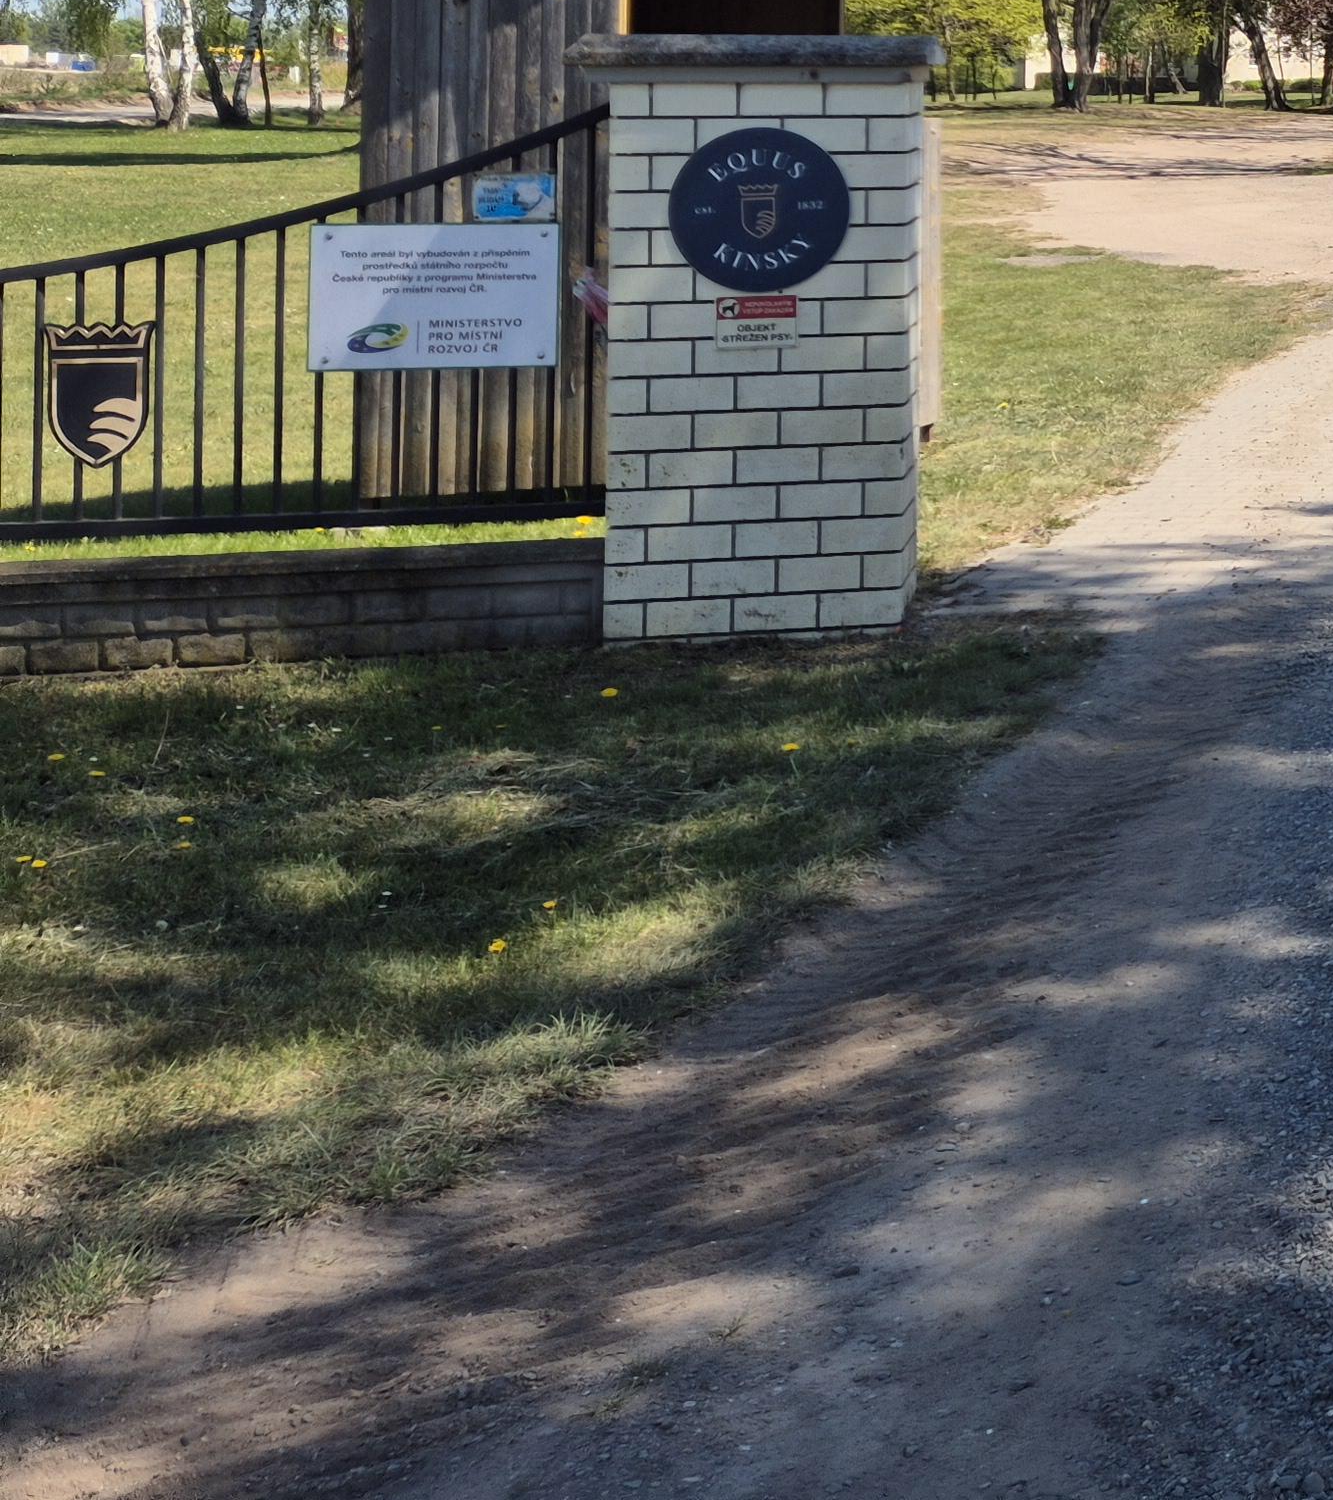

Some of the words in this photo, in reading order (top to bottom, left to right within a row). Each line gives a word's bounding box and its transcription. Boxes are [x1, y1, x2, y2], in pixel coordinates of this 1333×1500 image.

[706, 148, 807, 183] EQUUS
[797, 199, 825, 210] 1832
[340, 250, 368, 258] Tento
[370, 249, 396, 258] areál
[398, 250, 414, 259] byl
[416, 249, 471, 259] vybudován
[480, 248, 531, 258] přispěním
[712, 233, 812, 272] KINSKY
[362, 262, 418, 271] prostředků
[420, 260, 462, 269] státního
[463, 260, 508, 270] rozpočtu
[332, 274, 364, 282] České
[367, 274, 413, 283] republiky
[424, 274, 474, 283] programu
[476, 272, 537, 281] Ministerstva
[382, 287, 400, 295] pro
[402, 284, 433, 293] místní
[435, 285, 466, 294] rozvoj
[428, 318, 523, 329] MINISTERSTVO
[737, 322, 777, 332] OBJEKT
[428, 332, 454, 341] PRO
[458, 330, 503, 340] MÍSTNÍ
[427, 344, 478, 354] ROZVOJ
[482, 342, 498, 353] ČR
